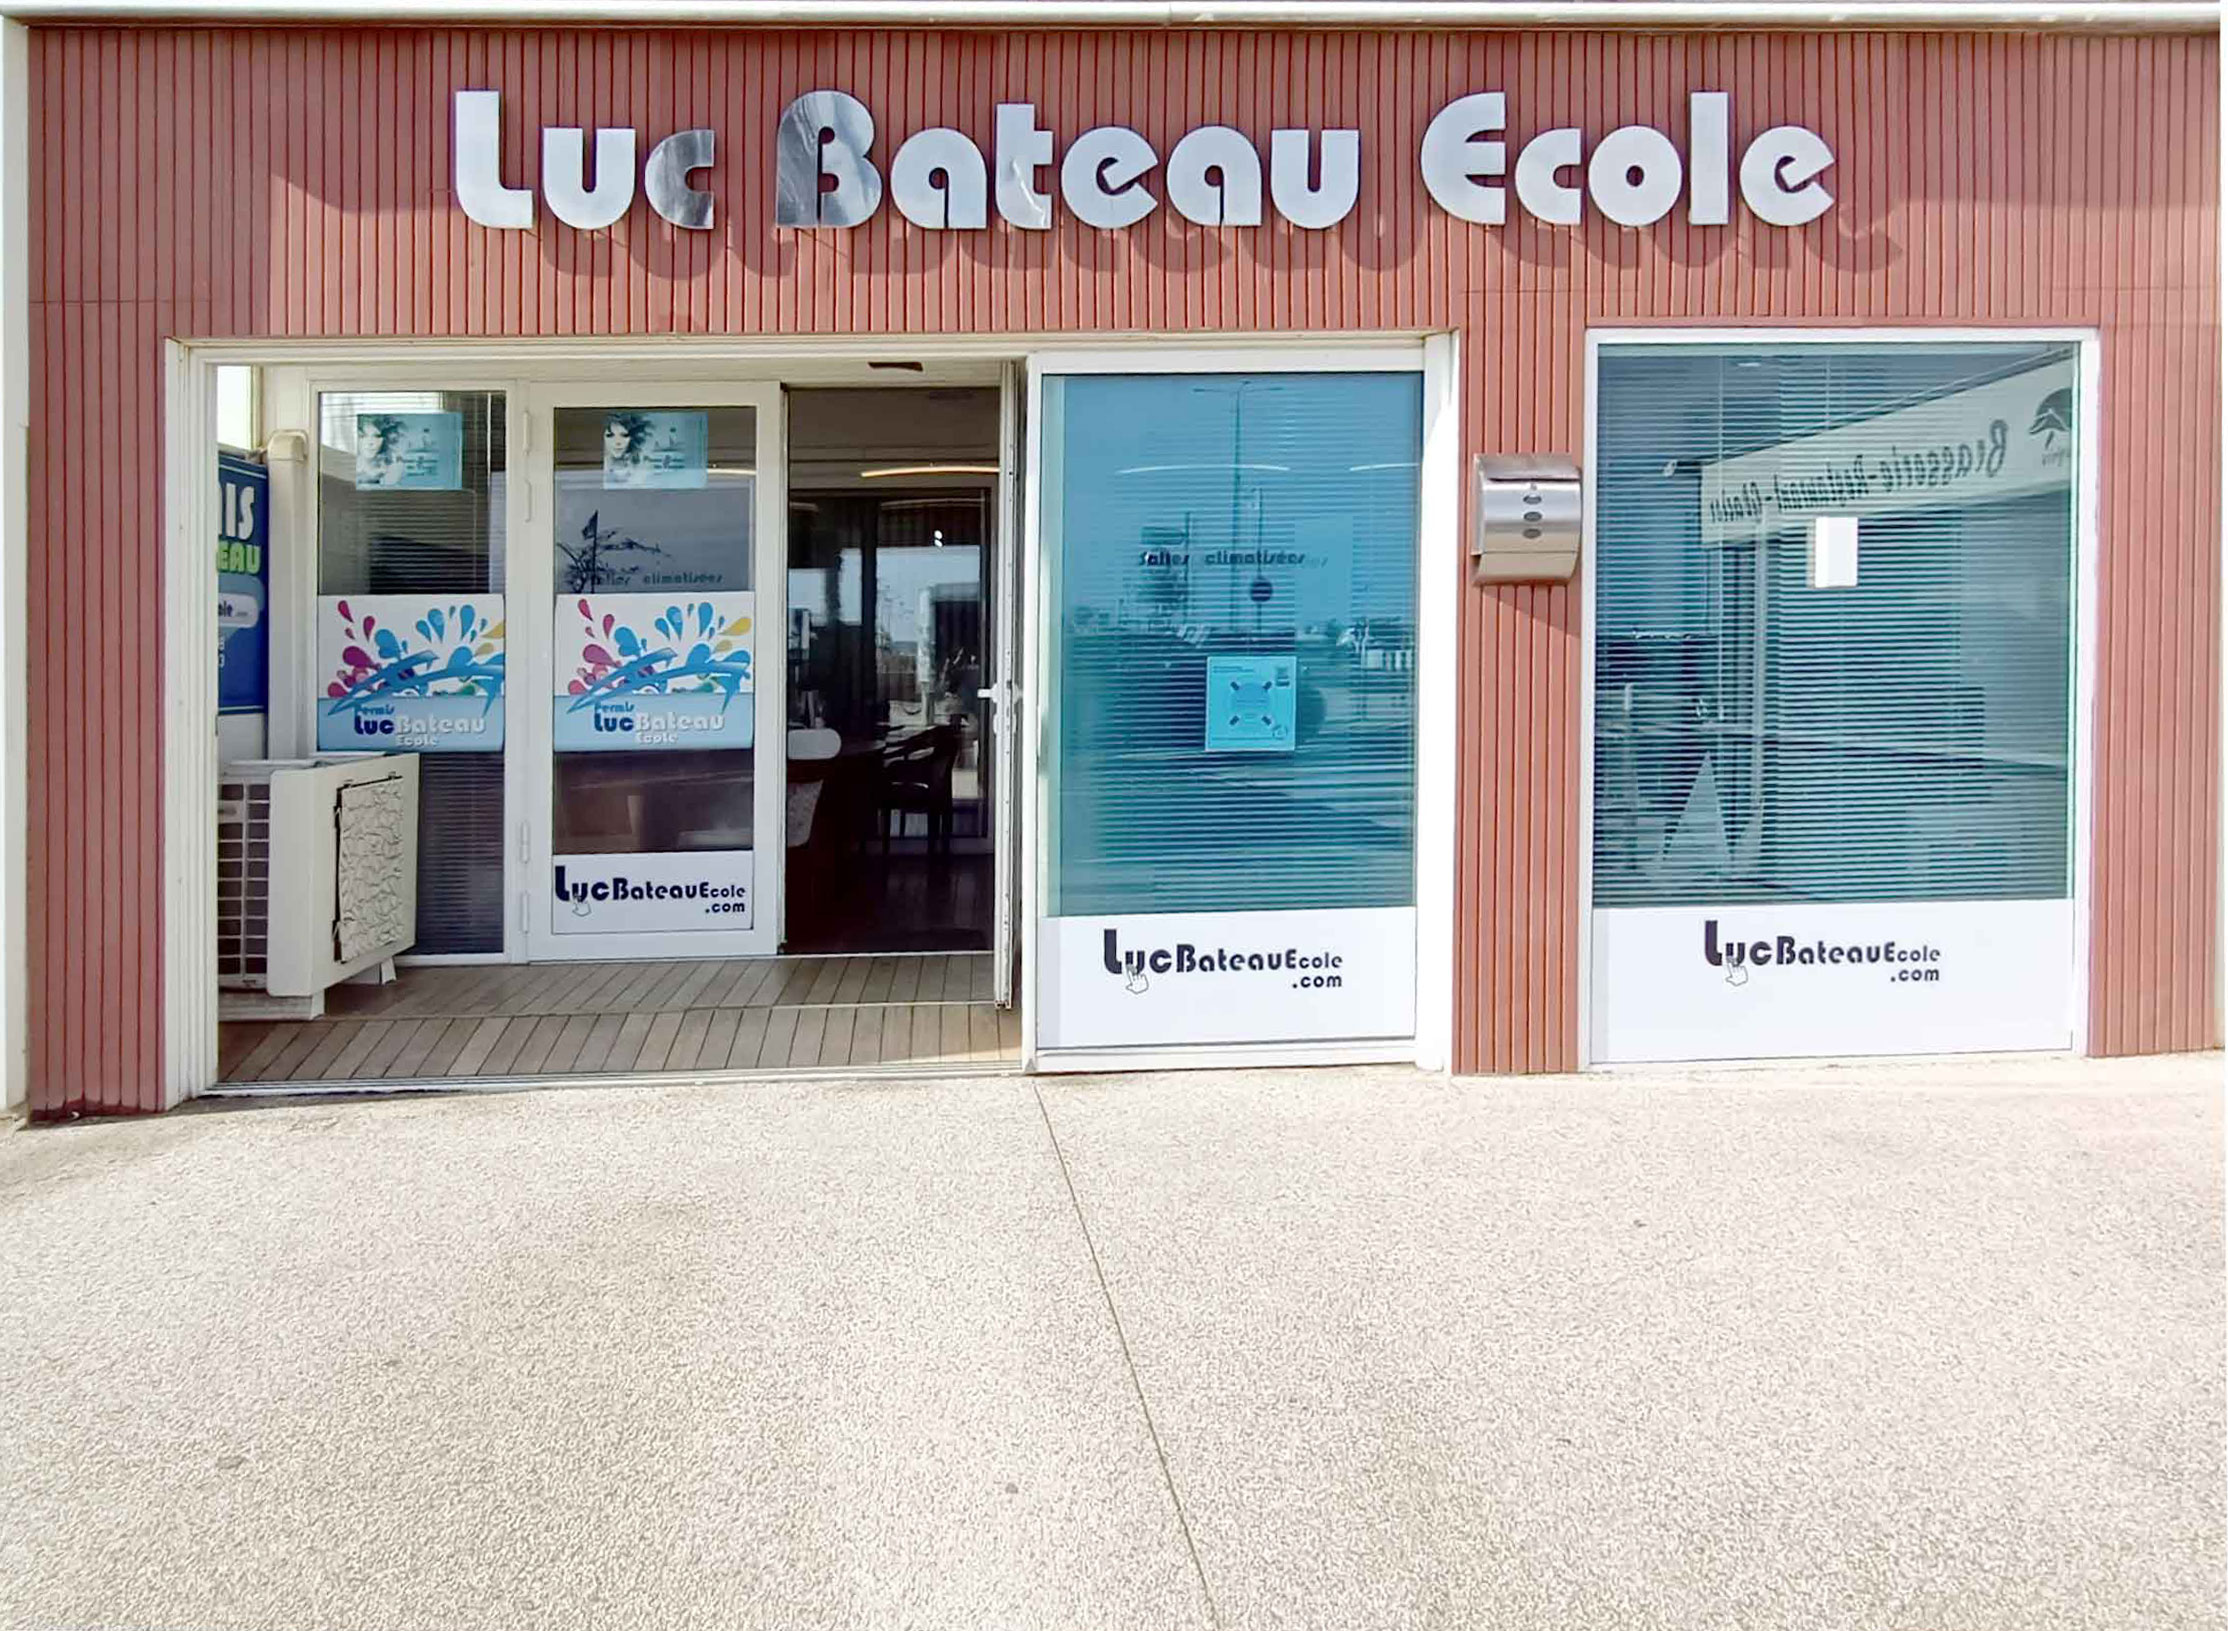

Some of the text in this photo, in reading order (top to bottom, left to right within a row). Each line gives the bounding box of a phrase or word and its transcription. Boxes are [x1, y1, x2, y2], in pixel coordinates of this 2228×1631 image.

[455, 90, 1835, 230] Luc Bateau Ecole
[218, 482, 255, 540] IS
[555, 865, 746, 902] LucBateauEcole
[705, 903, 745, 914] .com
[1103, 929, 1343, 974] LucBateauEcole
[1704, 920, 1941, 966] LucBateauEcole
[1292, 975, 1343, 989] .com
[1890, 969, 1940, 982] .com
